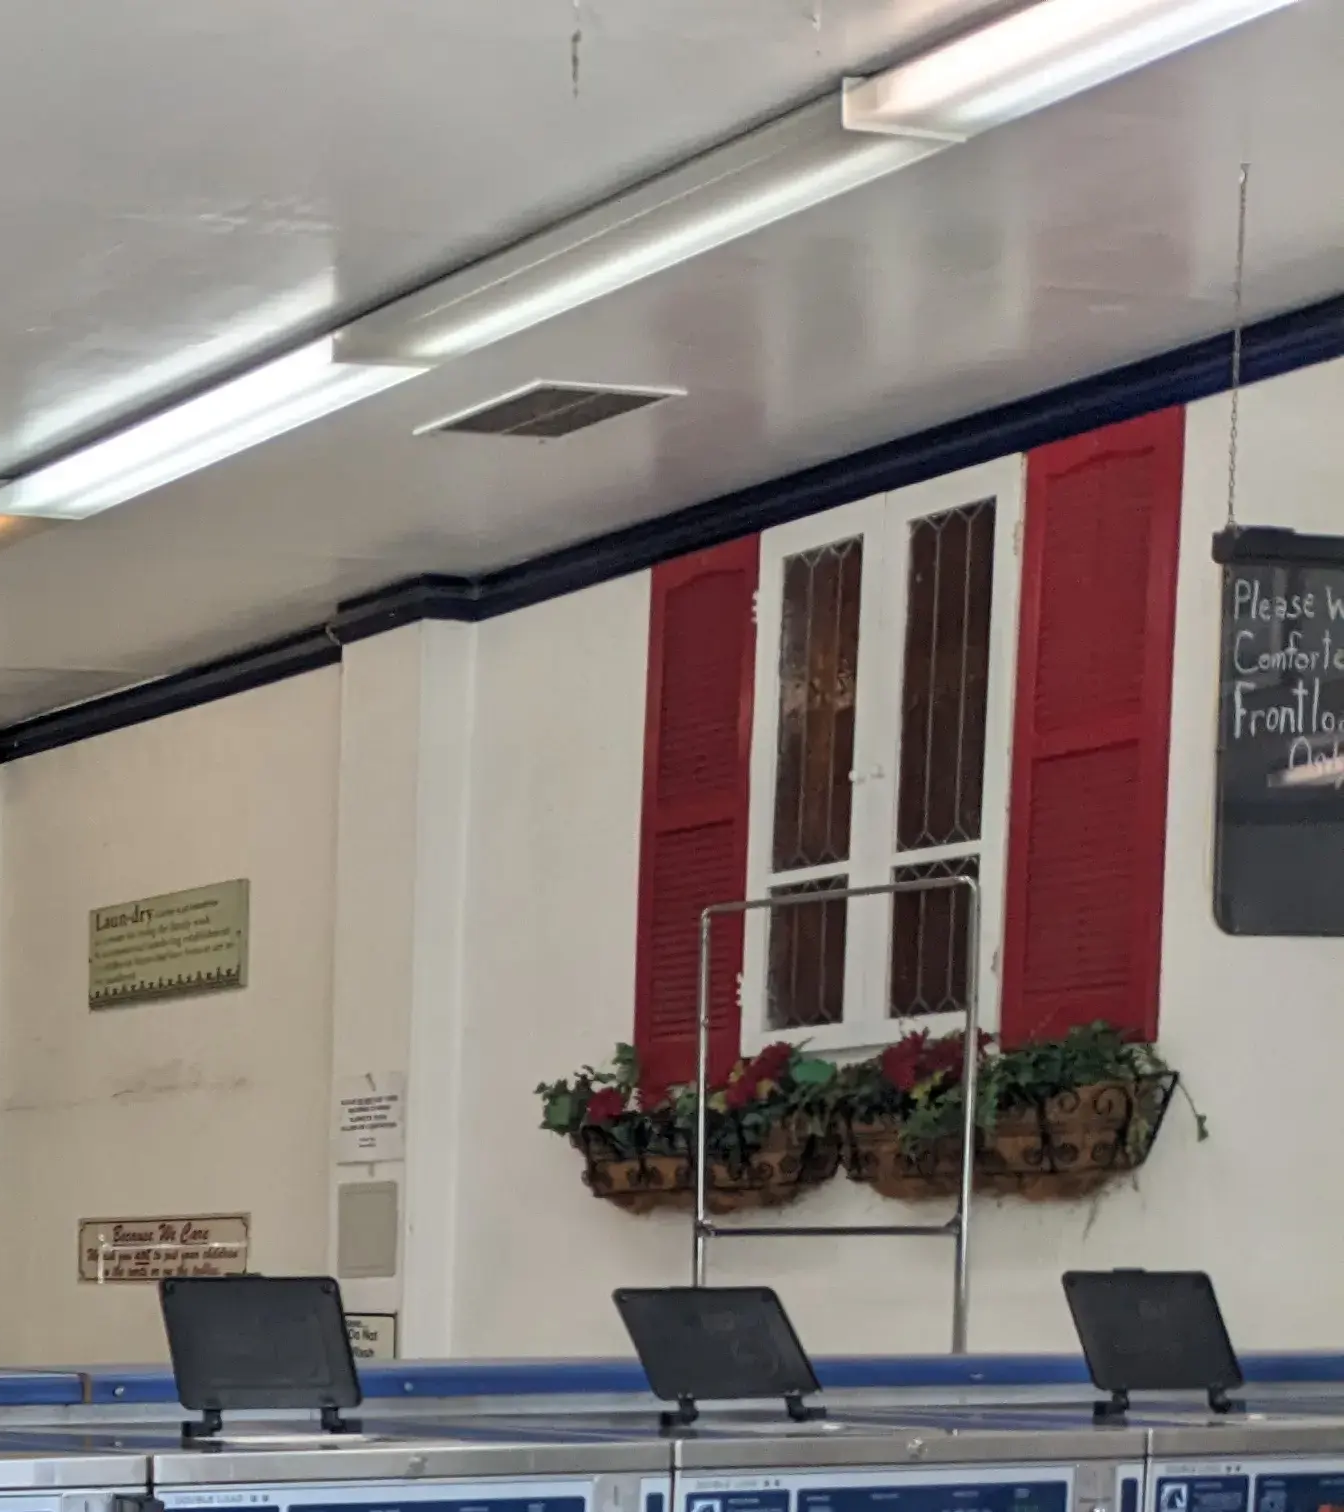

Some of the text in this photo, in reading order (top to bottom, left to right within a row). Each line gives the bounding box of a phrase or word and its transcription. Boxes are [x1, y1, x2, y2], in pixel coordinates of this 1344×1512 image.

[1234, 578, 1315, 621] Please
[113, 1221, 209, 1244] Because We Care
